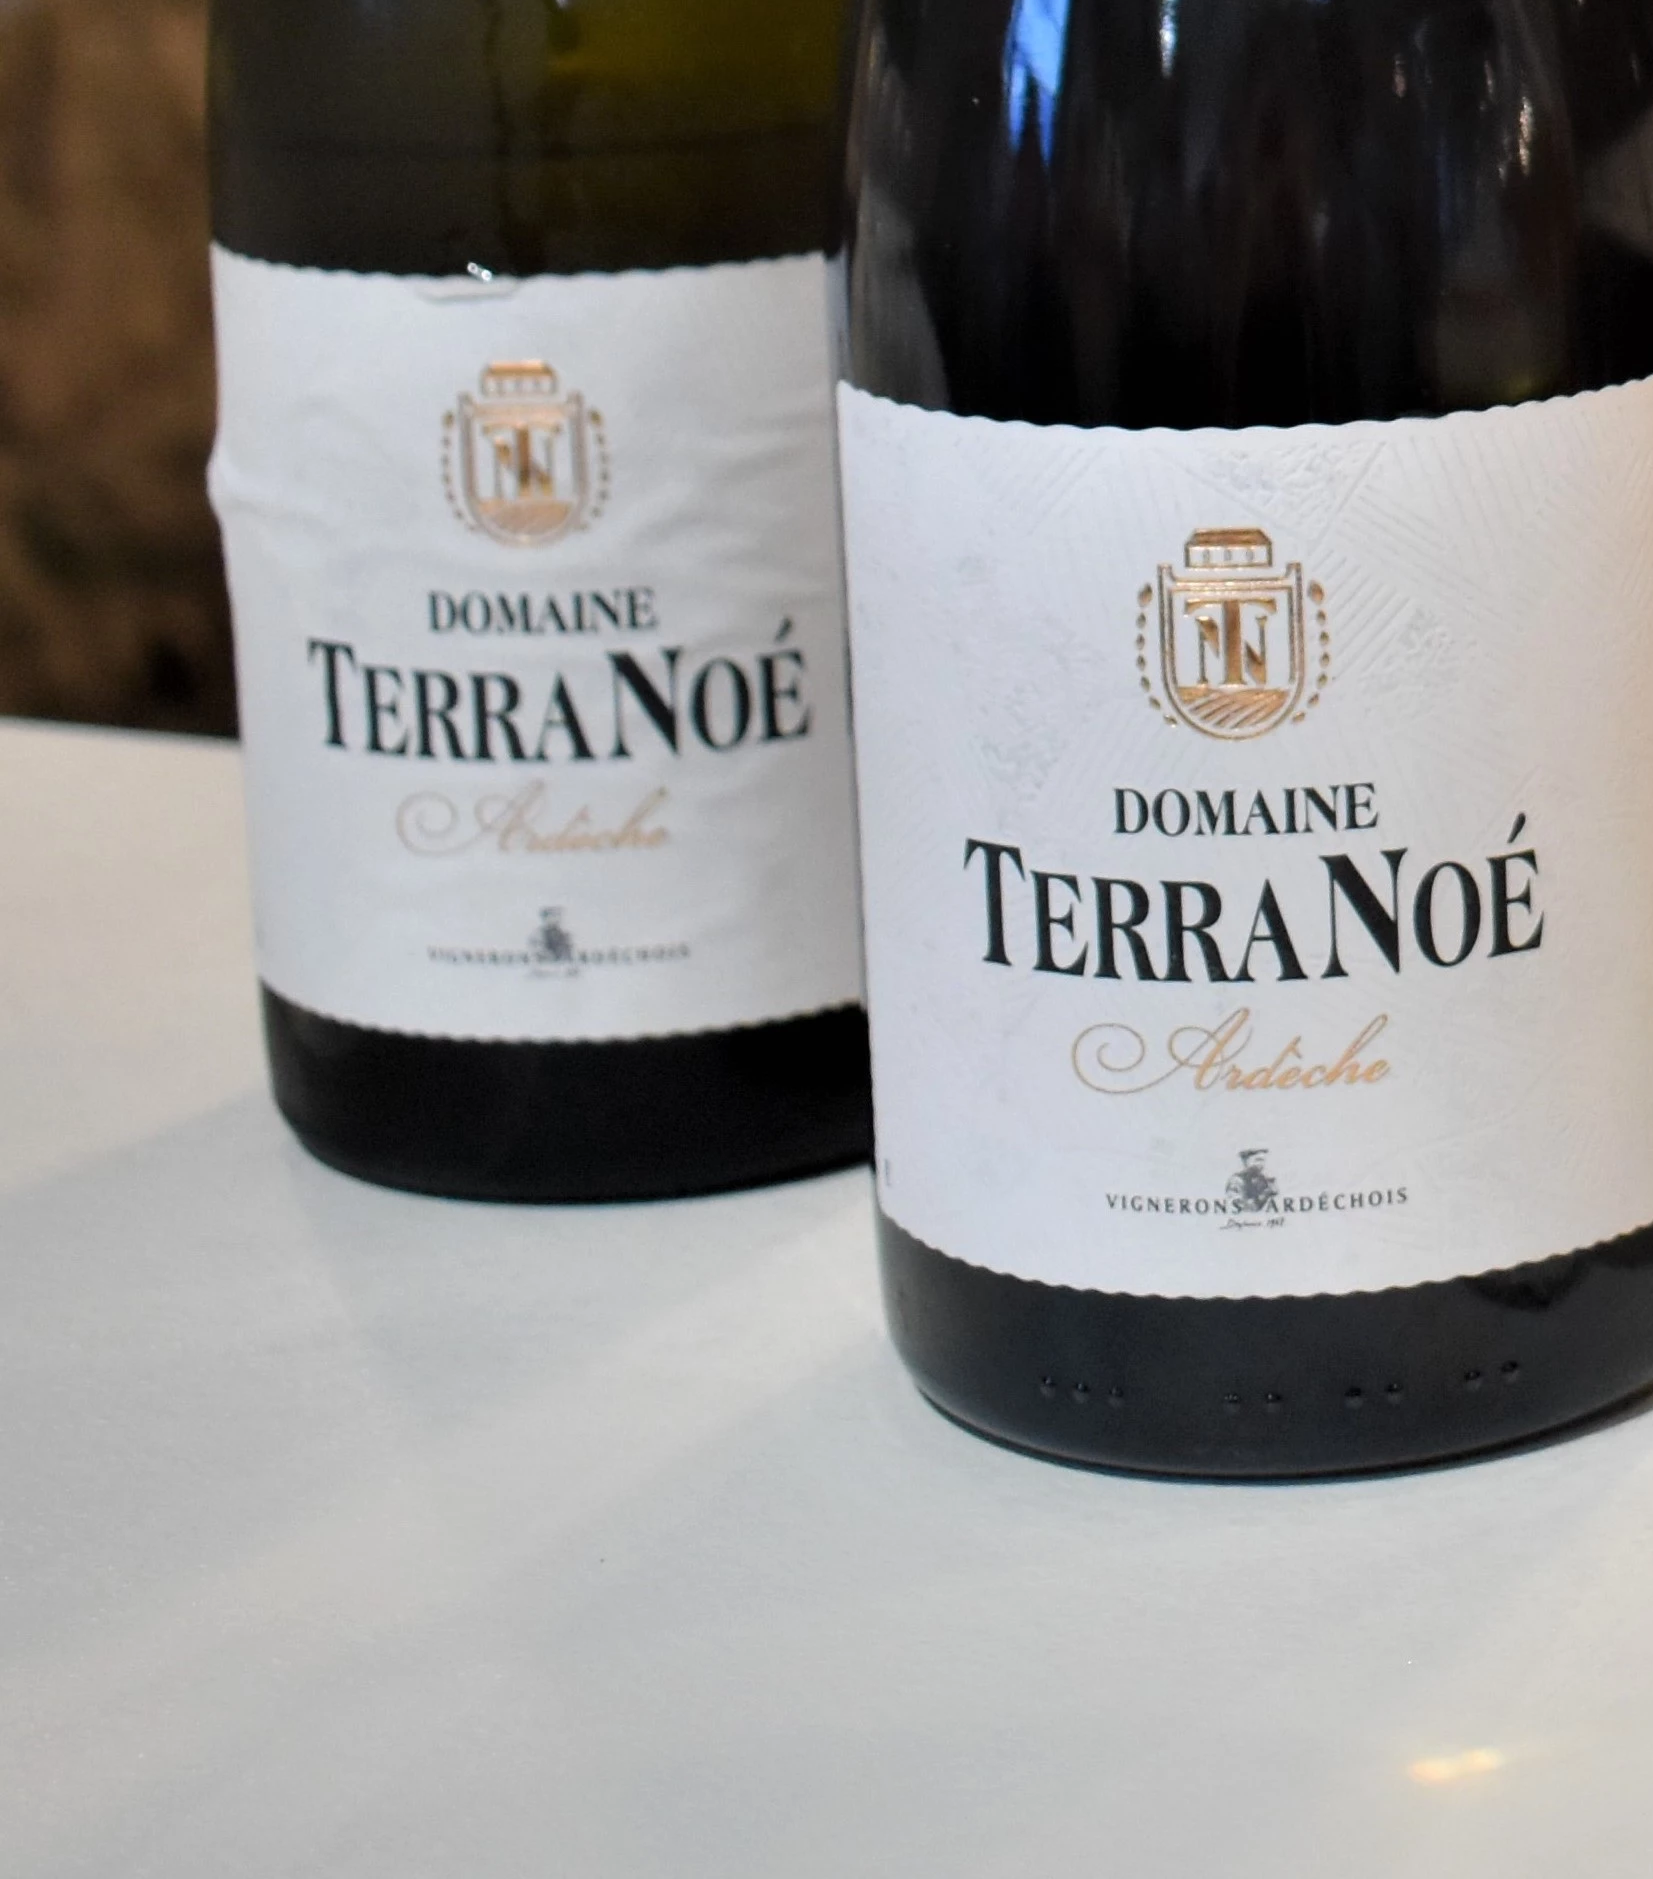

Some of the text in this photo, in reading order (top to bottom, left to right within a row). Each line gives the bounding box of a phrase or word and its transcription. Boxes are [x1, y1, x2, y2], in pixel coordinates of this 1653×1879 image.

[428, 587, 657, 634] DOMAINE
[1113, 782, 1379, 837] DOMAINE
[1071, 1007, 1391, 1095] Ardèche
[1105, 1186, 1409, 1215] VIGNERONS ARDÉCHOIS
